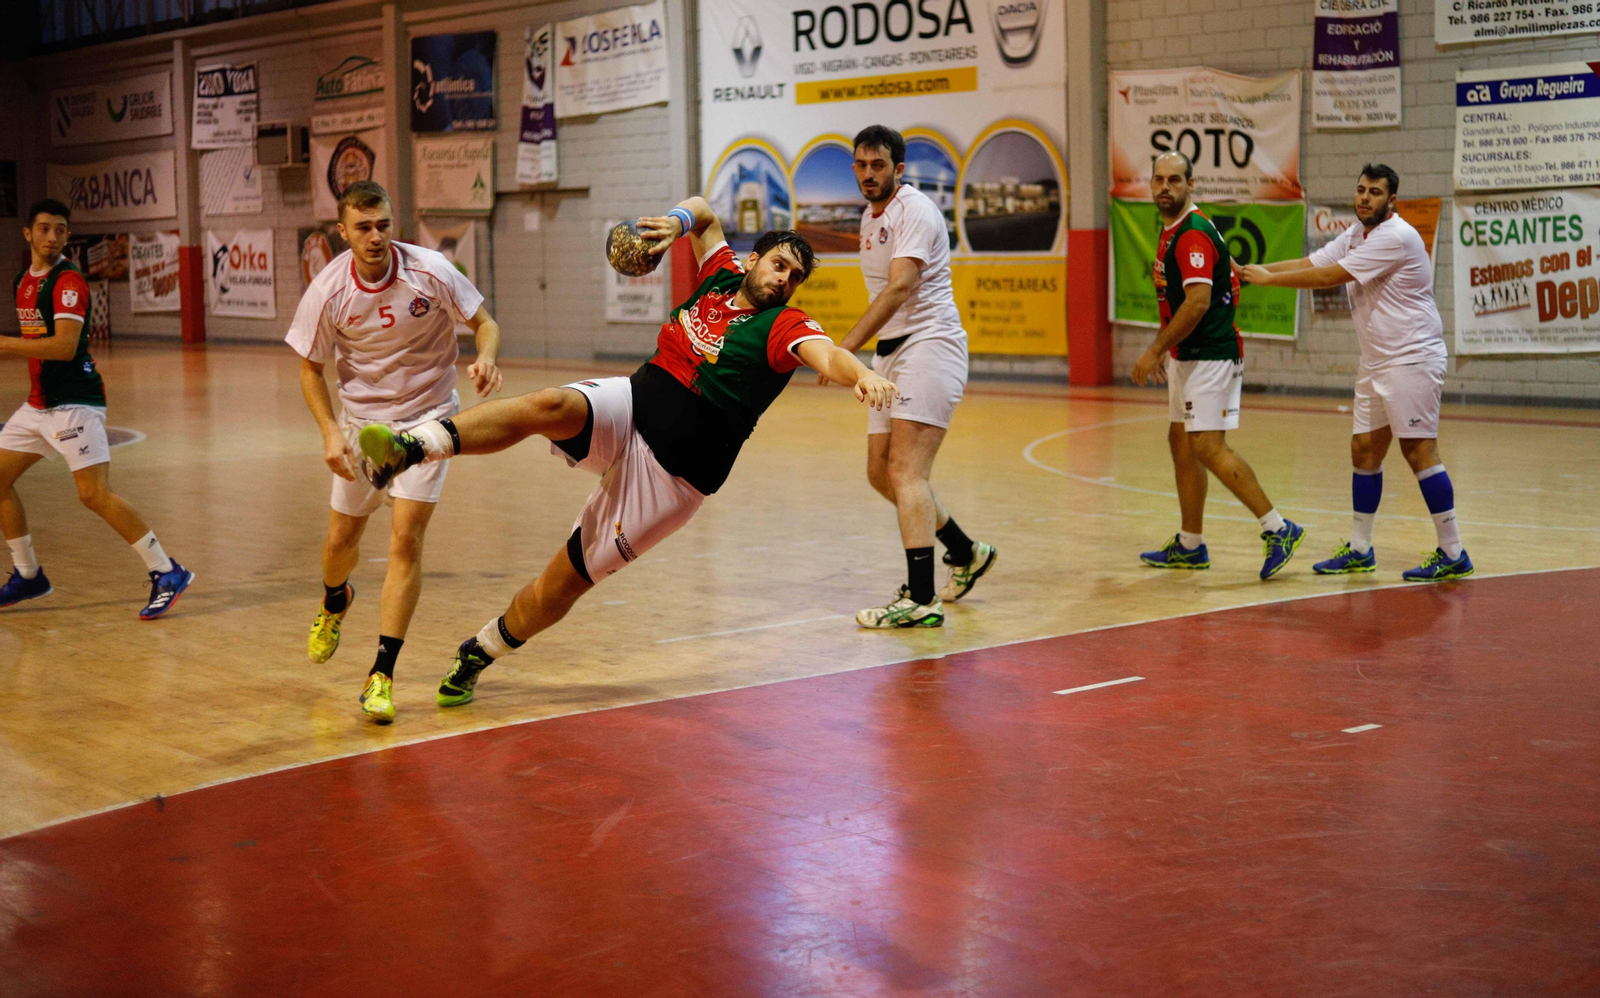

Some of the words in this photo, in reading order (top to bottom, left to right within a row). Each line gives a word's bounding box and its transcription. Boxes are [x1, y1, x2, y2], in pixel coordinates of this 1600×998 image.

[998, 2, 1037, 15] DACIA
[1448, 14, 1467, 25] Tel.
[1470, 13, 1490, 24] 986
[1494, 11, 1512, 22] 227
[1515, 9, 1534, 20] 754
[1545, 7, 1569, 18] Fax.
[1572, 4, 1593, 15] 986
[1468, 0, 1508, 10] Ricardo
[793, 0, 973, 52] RODOSA
[1353, 39, 1360, 51] Y
[794, 62, 815, 75] VIGO
[863, 52, 902, 69] CANGAS
[909, 46, 978, 65] PONTEAREAS
[713, 83, 786, 101] RENAULT
[818, 76, 950, 101] www.rodosa.com
[1500, 81, 1534, 103] Grupo
[1536, 75, 1585, 100] Regueira
[1193, 112, 1206, 124] DE
[1462, 112, 1512, 124] CENTRAL:
[1151, 127, 1255, 169] SOTO
[1462, 139, 1477, 149] Tel.
[1478, 138, 1494, 148] 986
[1496, 136, 1511, 147] 376
[1535, 134, 1550, 145] Fax
[1552, 133, 1568, 144] 986
[1570, 132, 1584, 143] 376
[1461, 150, 1532, 163] SUCURSALES:
[1560, 160, 1576, 171] 986
[1578, 159, 1592, 170] 471
[1568, 172, 1584, 183] 986
[69, 167, 157, 210] ABANCA
[1474, 200, 1519, 215] CENTRO
[1521, 196, 1563, 212] MÉDICO
[1460, 214, 1583, 247] CESANTES
[229, 243, 267, 271] Orka
[1470, 258, 1534, 287] Estamos
[1539, 251, 1570, 275] con
[1576, 245, 1592, 268] el
[975, 277, 1058, 293] PONTEAREAS
[378, 305, 395, 328] 5
